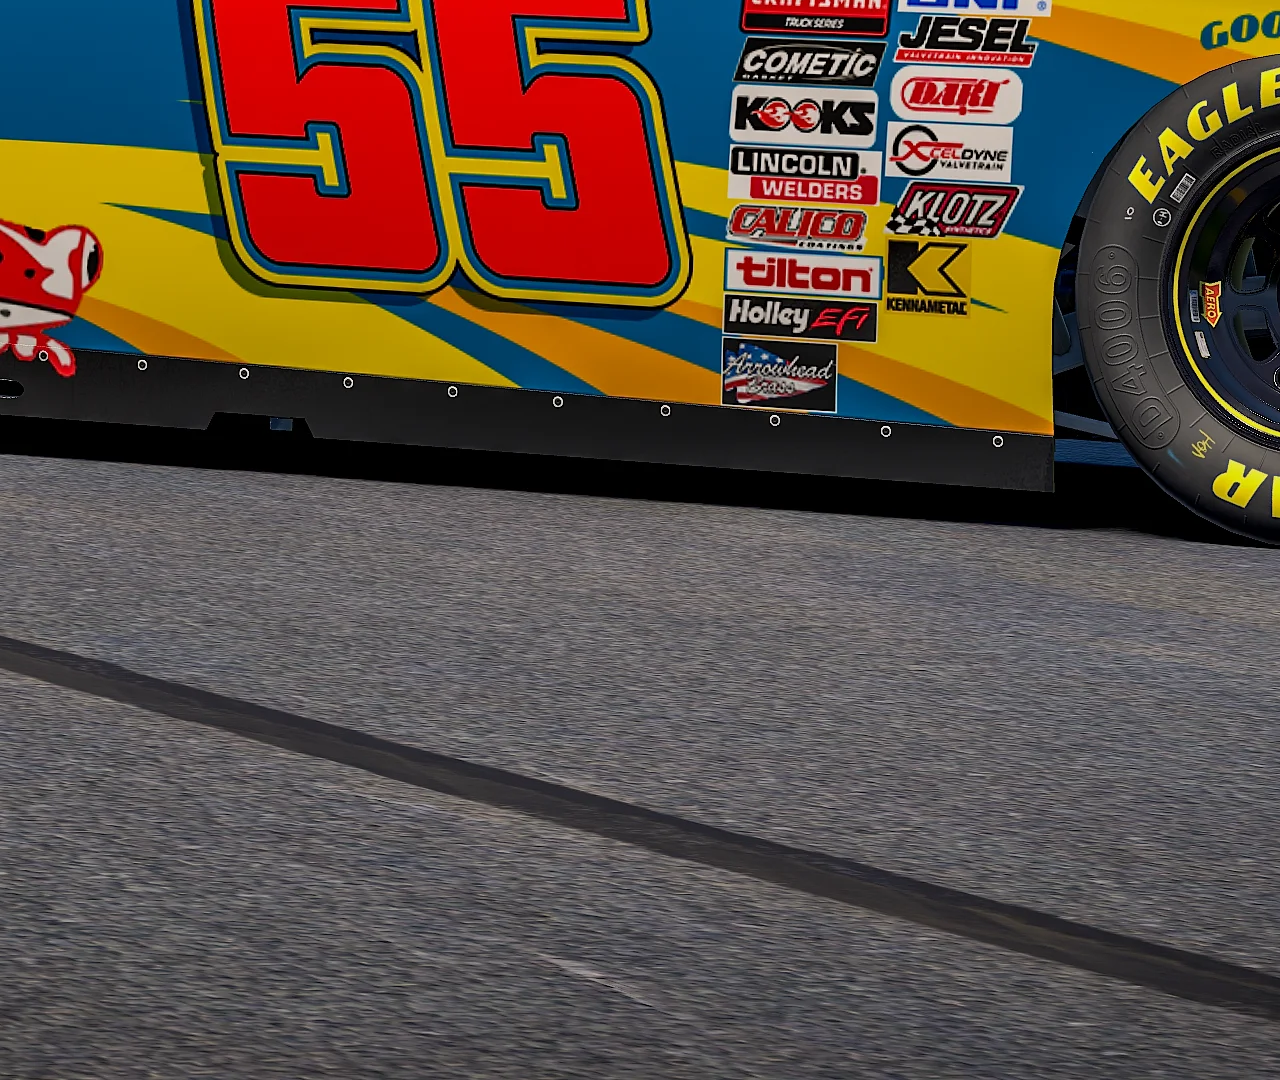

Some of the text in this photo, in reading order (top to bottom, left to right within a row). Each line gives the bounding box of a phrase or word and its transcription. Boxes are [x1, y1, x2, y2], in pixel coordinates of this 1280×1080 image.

[899, 15, 1037, 53] JESEL
[742, 47, 878, 78] COMETIC
[734, 94, 876, 136] KOOKS
[737, 151, 853, 177] LINCOLN
[940, 160, 1004, 171] VALVETRAIN
[762, 179, 863, 201] WELDERS
[730, 206, 867, 242] CALICO
[905, 191, 1008, 226] KLOTZ
[736, 256, 871, 293] tilton
[729, 298, 810, 334] Holley
[886, 297, 968, 316] KENNAMETAL
[1204, 286, 1218, 319] AERO
